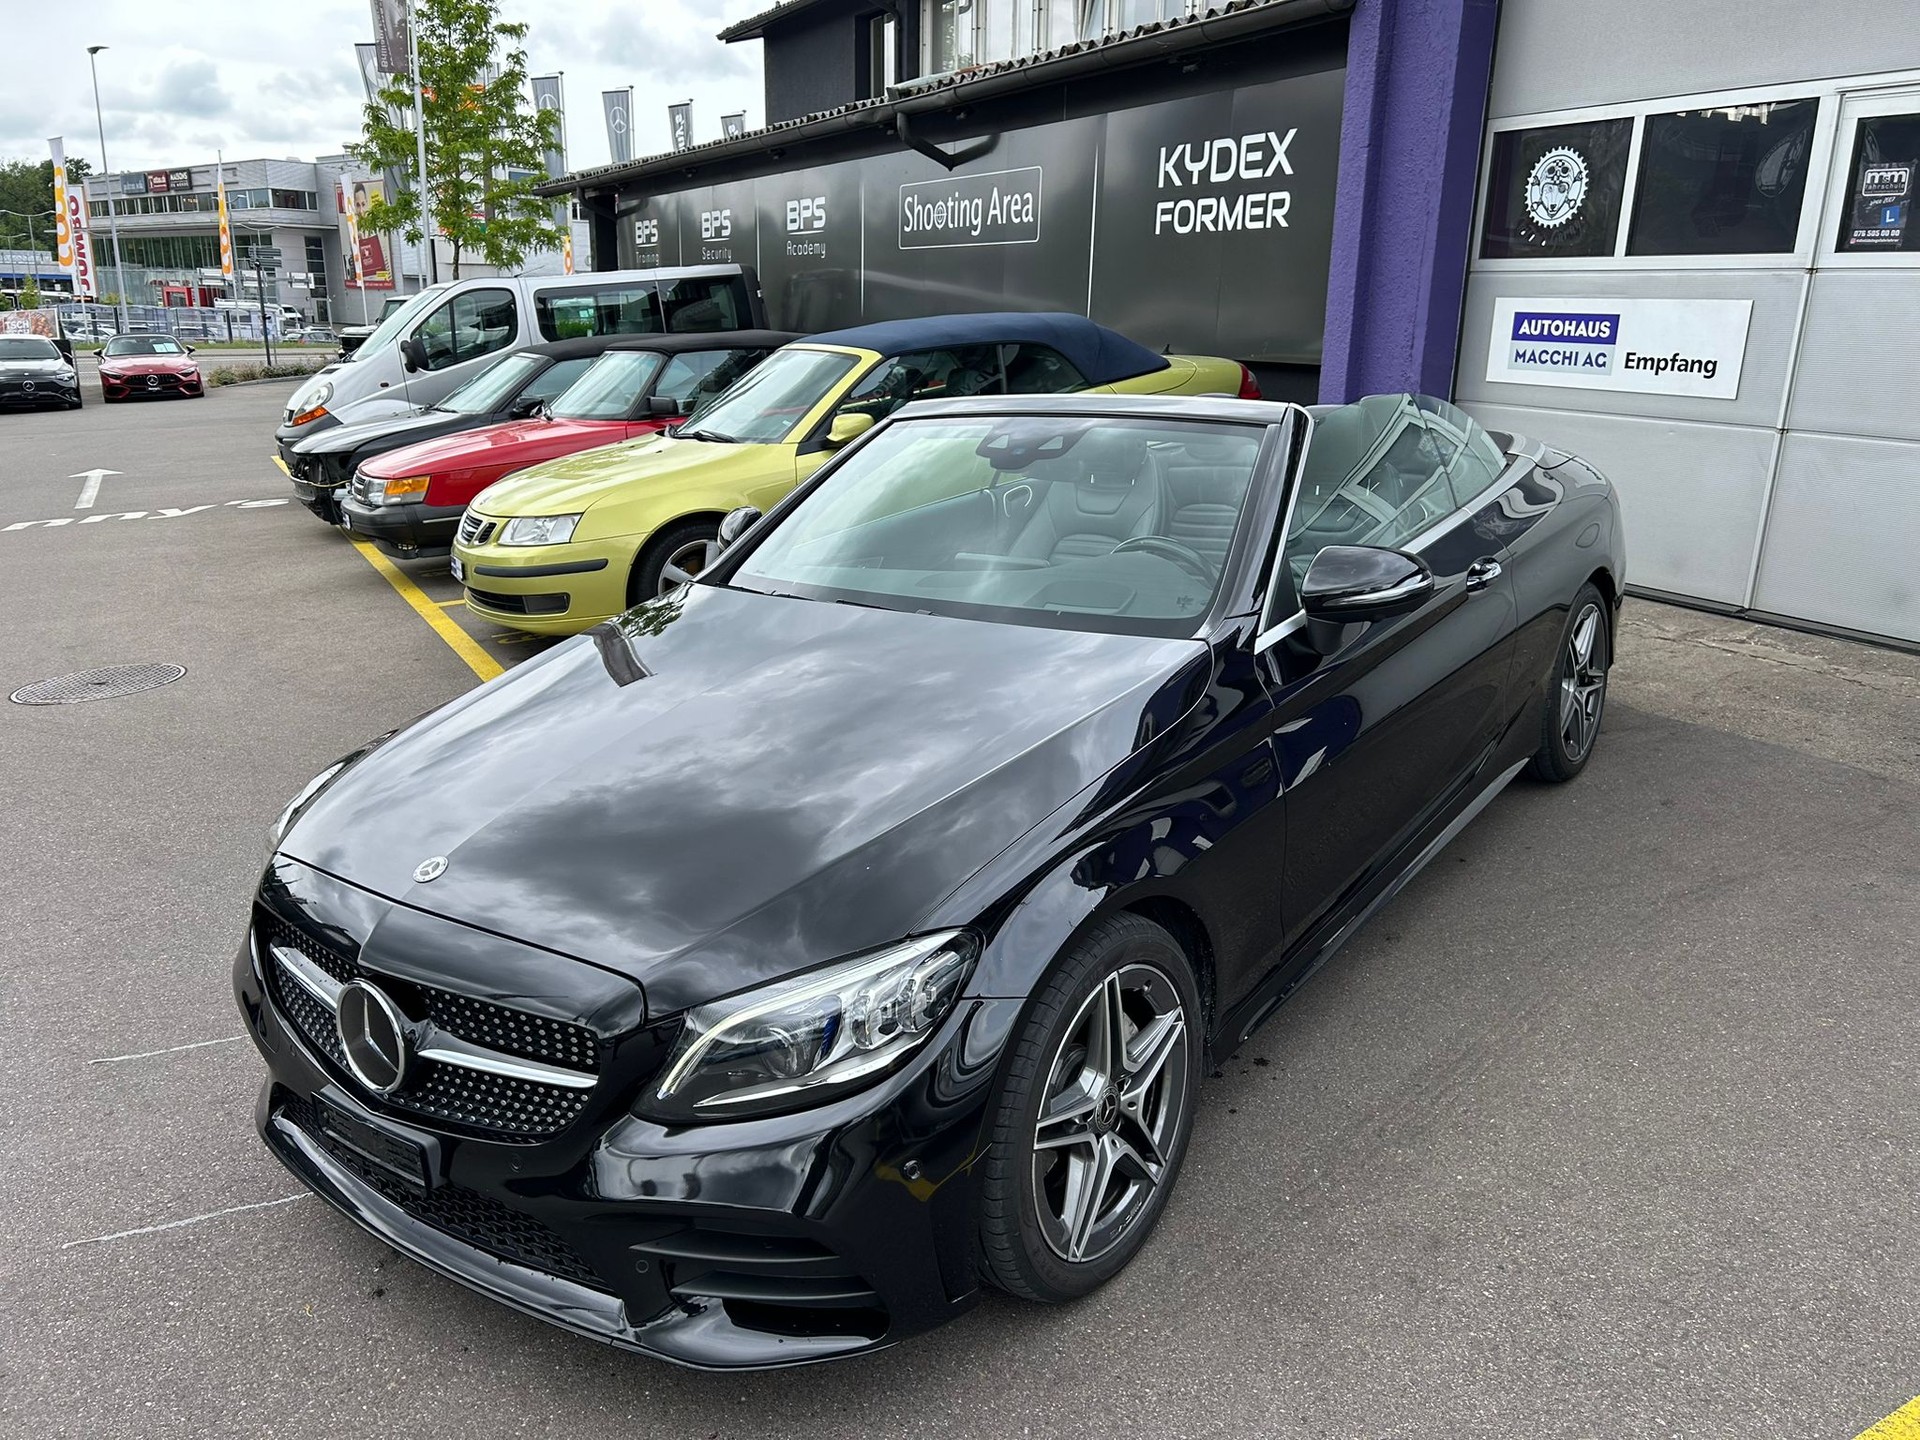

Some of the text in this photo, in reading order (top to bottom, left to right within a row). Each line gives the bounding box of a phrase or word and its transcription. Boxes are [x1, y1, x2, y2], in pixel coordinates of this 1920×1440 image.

[1158, 128, 1298, 188] KYDEX
[701, 209, 731, 238] BPS
[786, 196, 826, 231] BPS
[904, 187, 1034, 236] Shooting Area
[1155, 191, 1291, 235] FORMER
[1885, 210, 1895, 222] L
[635, 219, 659, 245] BPS
[635, 251, 659, 266] Training
[702, 246, 732, 263] Security
[786, 240, 826, 259] Academy
[1518, 319, 1611, 338] AUTOHAUS
[1514, 348, 1608, 368] MACCHI AG
[1624, 351, 1718, 379] Empfang
